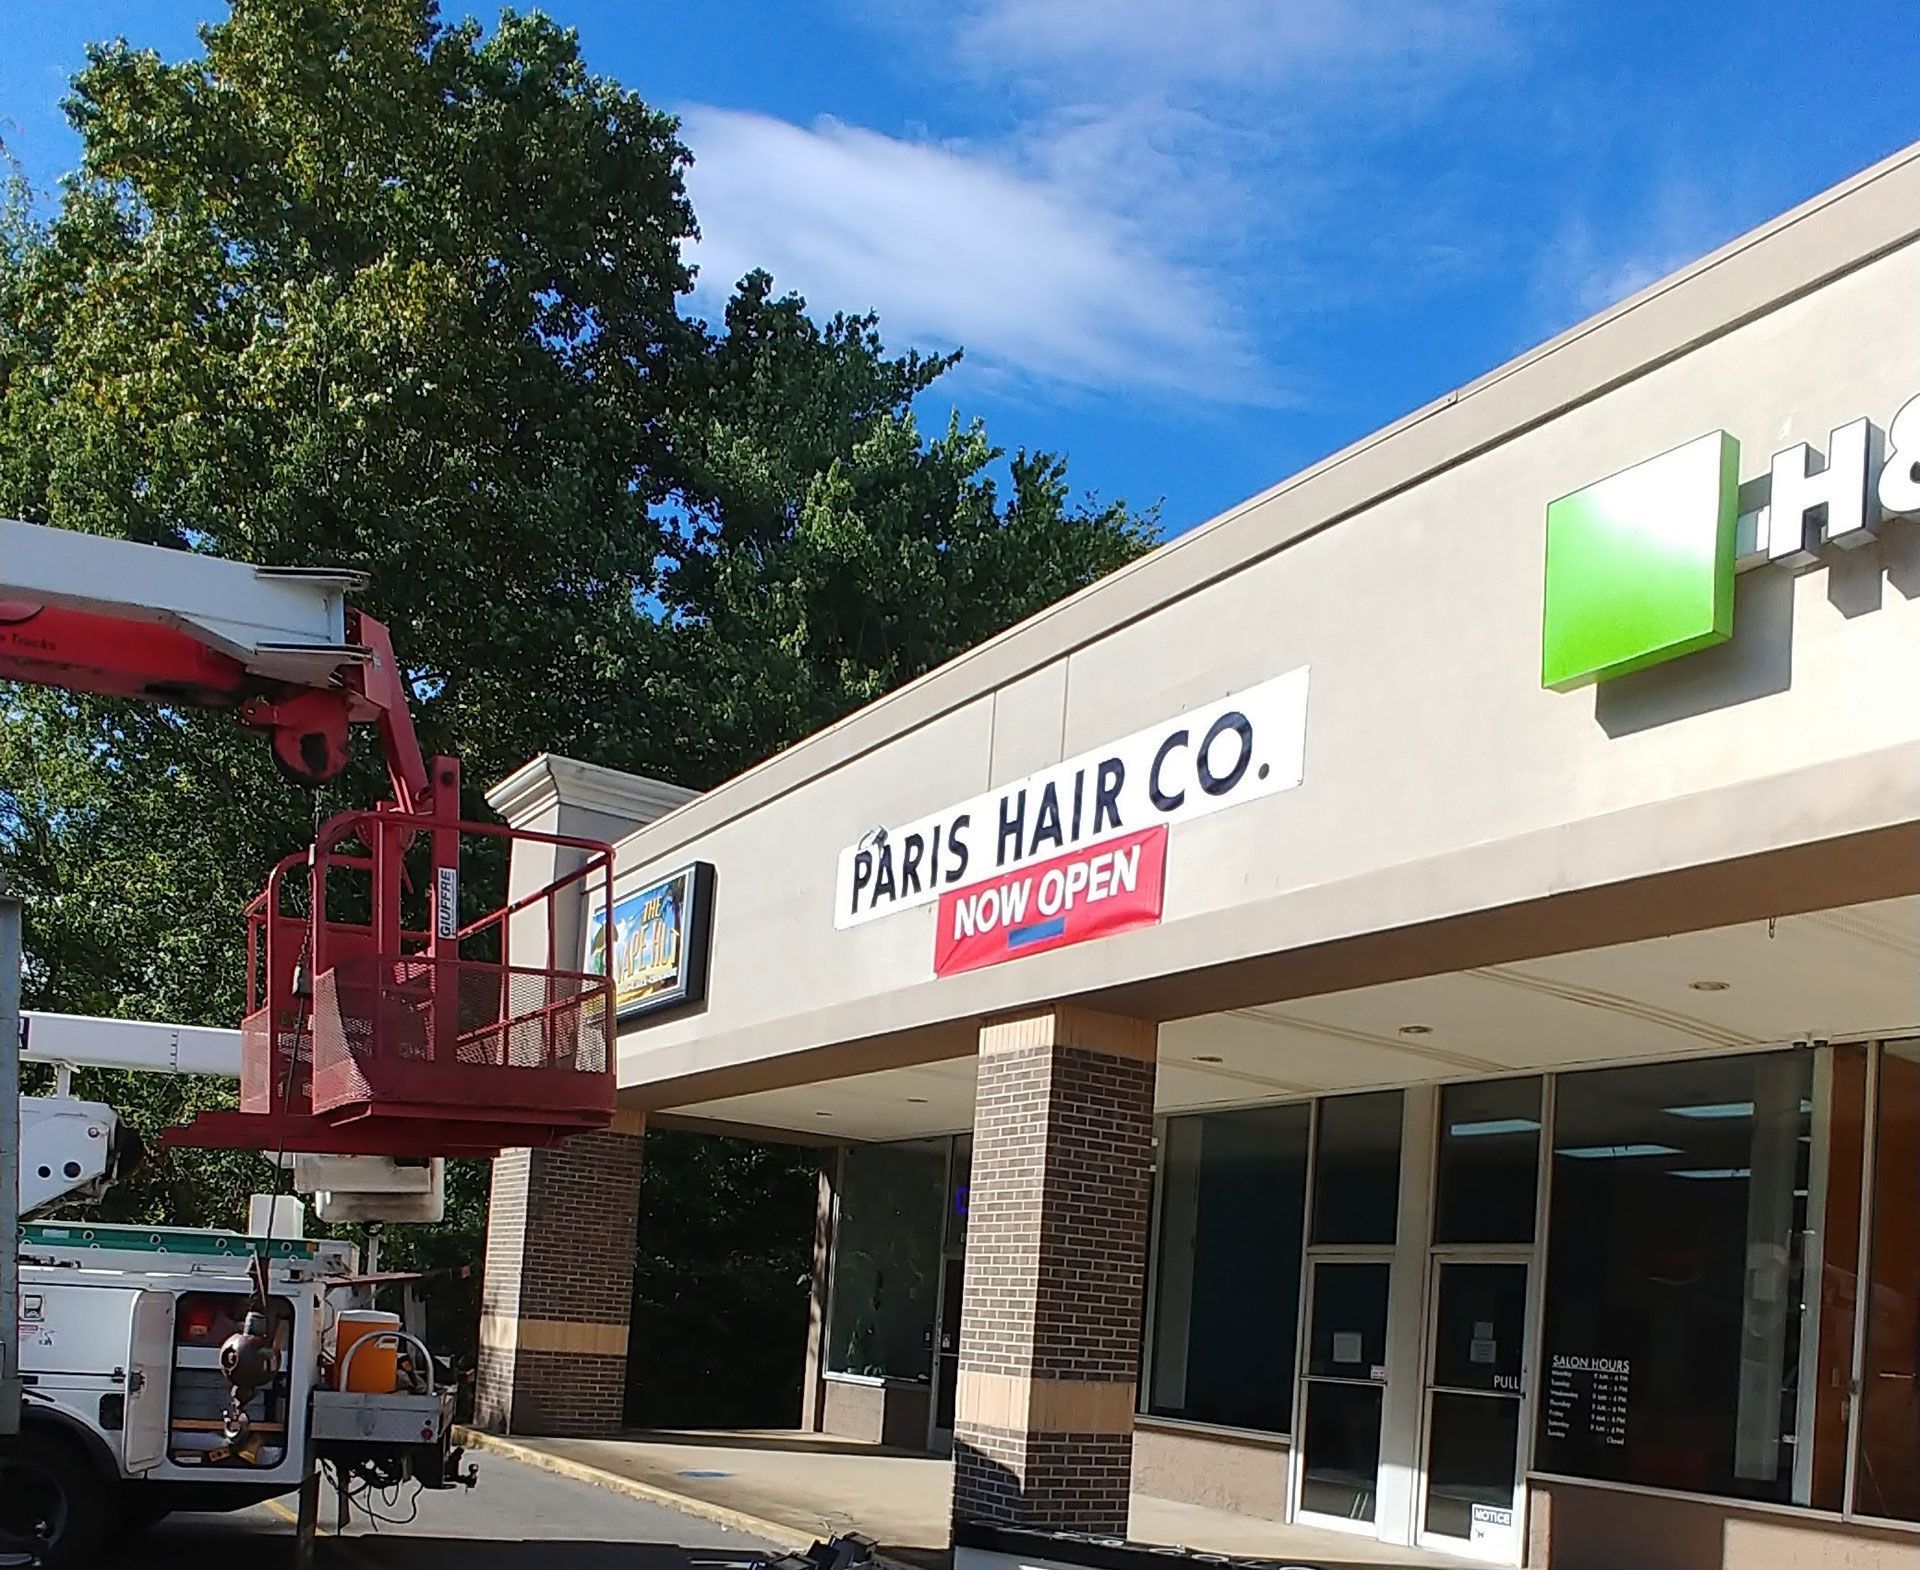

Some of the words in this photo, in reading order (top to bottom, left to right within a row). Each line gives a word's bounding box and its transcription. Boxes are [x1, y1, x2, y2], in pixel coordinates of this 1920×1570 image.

[850, 813, 972, 915] PARIS
[995, 756, 1126, 868] HAIR
[1148, 710, 1271, 813] CO.
[440, 869, 452, 938] GIUFFRE
[952, 874, 1034, 941] NOW
[1036, 843, 1141, 917] OPEN
[642, 895, 664, 924] THE
[1552, 1354, 1589, 1368] SALON
[1591, 1357, 1630, 1373] HOURS
[1493, 1374, 1519, 1390] PULL
[1475, 1508, 1510, 1525] NOTICE
